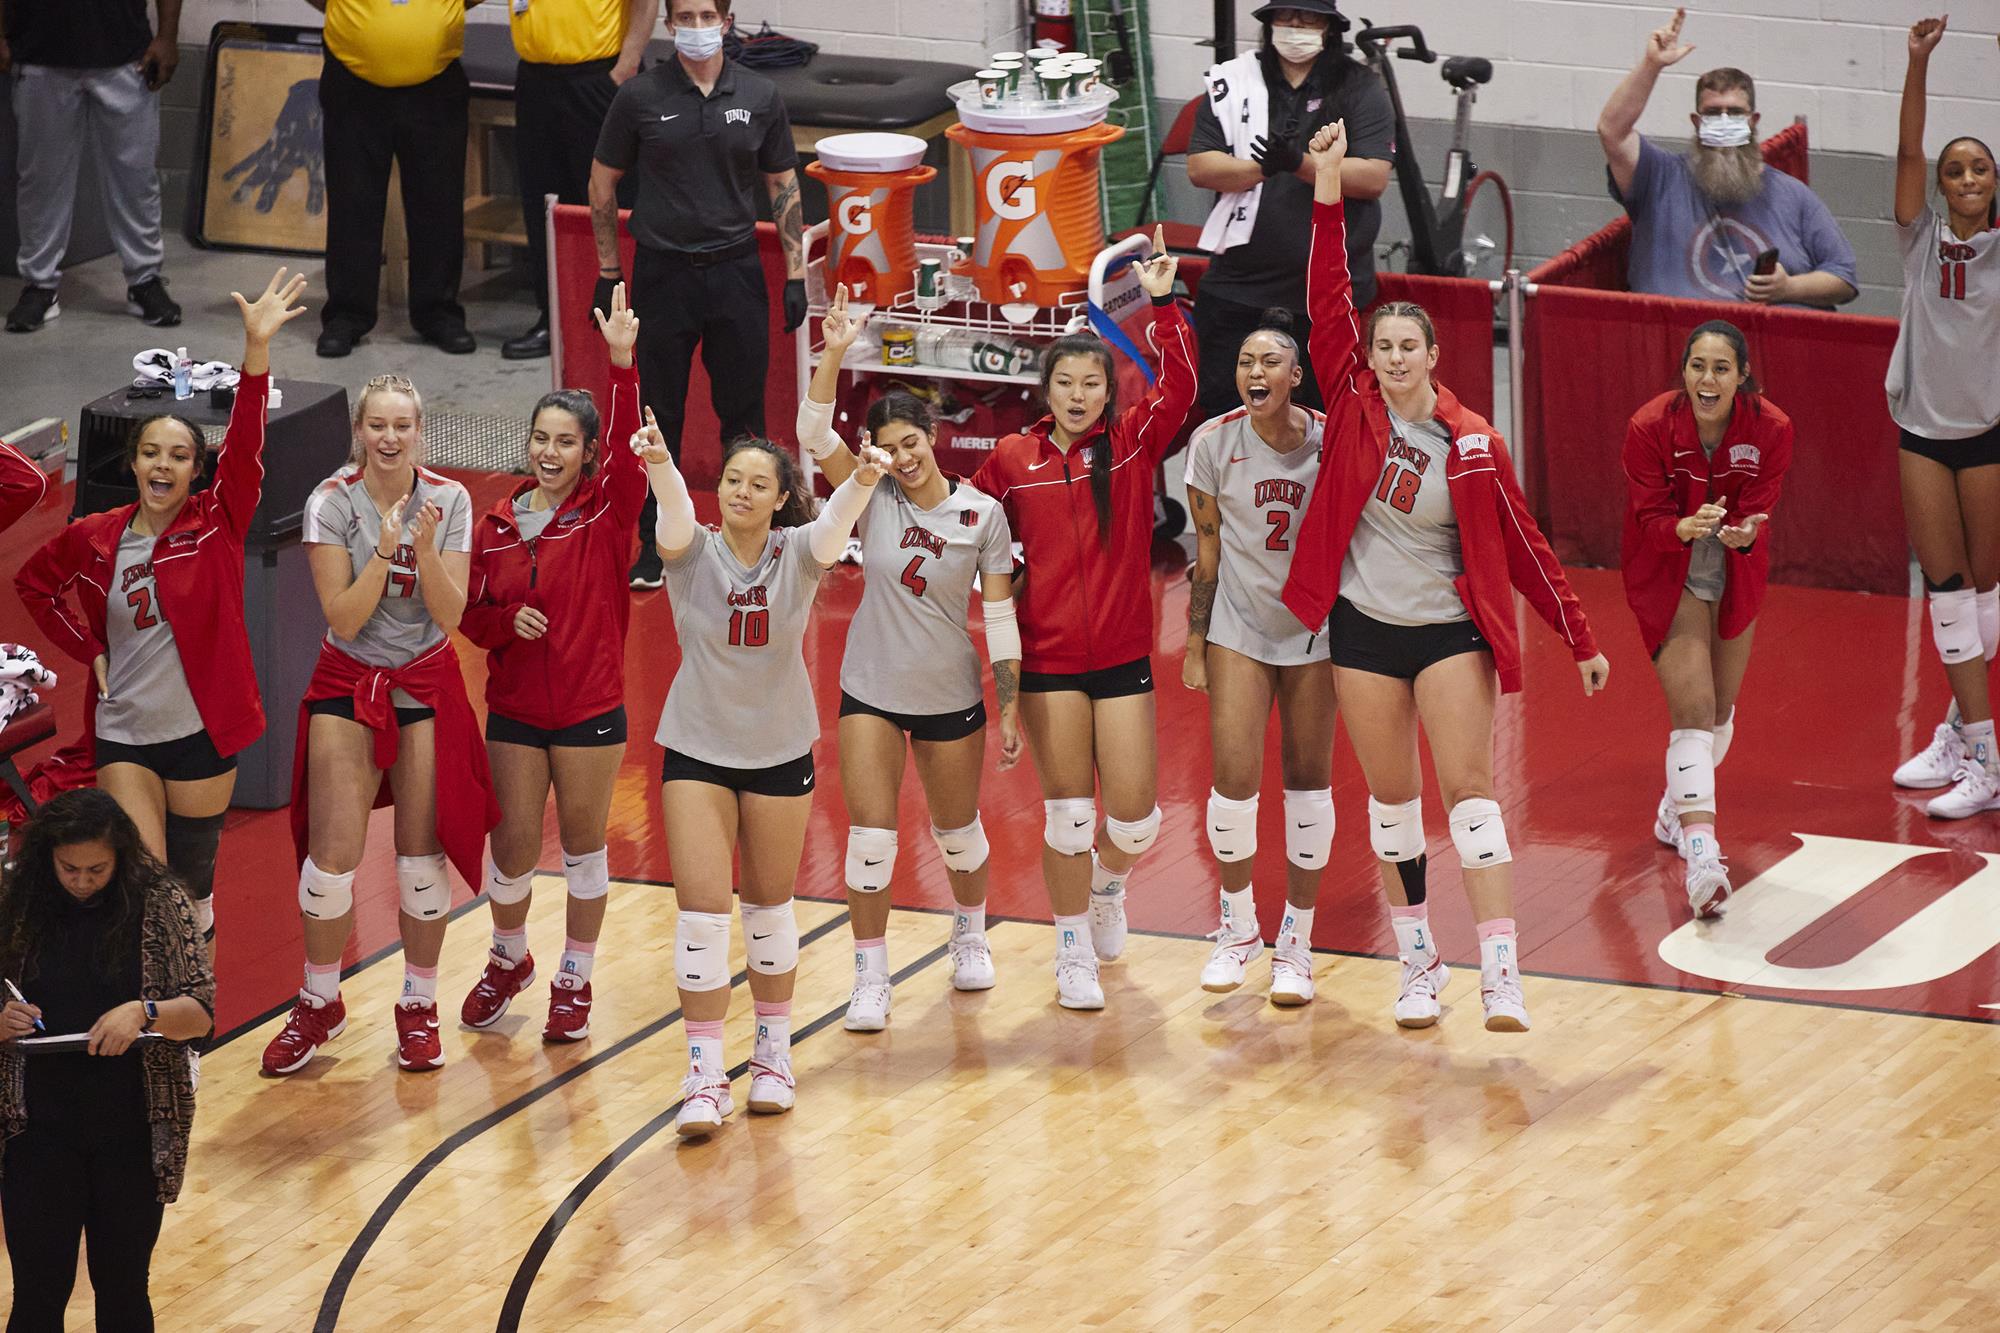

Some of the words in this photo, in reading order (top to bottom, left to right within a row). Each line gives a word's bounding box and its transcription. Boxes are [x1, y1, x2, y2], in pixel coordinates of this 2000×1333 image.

[724, 108, 751, 124] UNLV
[986, 160, 1036, 220] G
[838, 196, 872, 234] G
[1940, 262, 1966, 300] 11
[951, 436, 997, 450] MERET
[1388, 437, 1431, 475] UNLV
[1455, 434, 1490, 456] UNLV
[1729, 444, 1761, 464] UNLV
[1254, 479, 1306, 510] UNLV
[1376, 462, 1421, 514] 18
[900, 526, 947, 559] UNLV
[1265, 511, 1290, 551] 2
[901, 555, 927, 597] 4
[729, 609, 769, 646] 10
